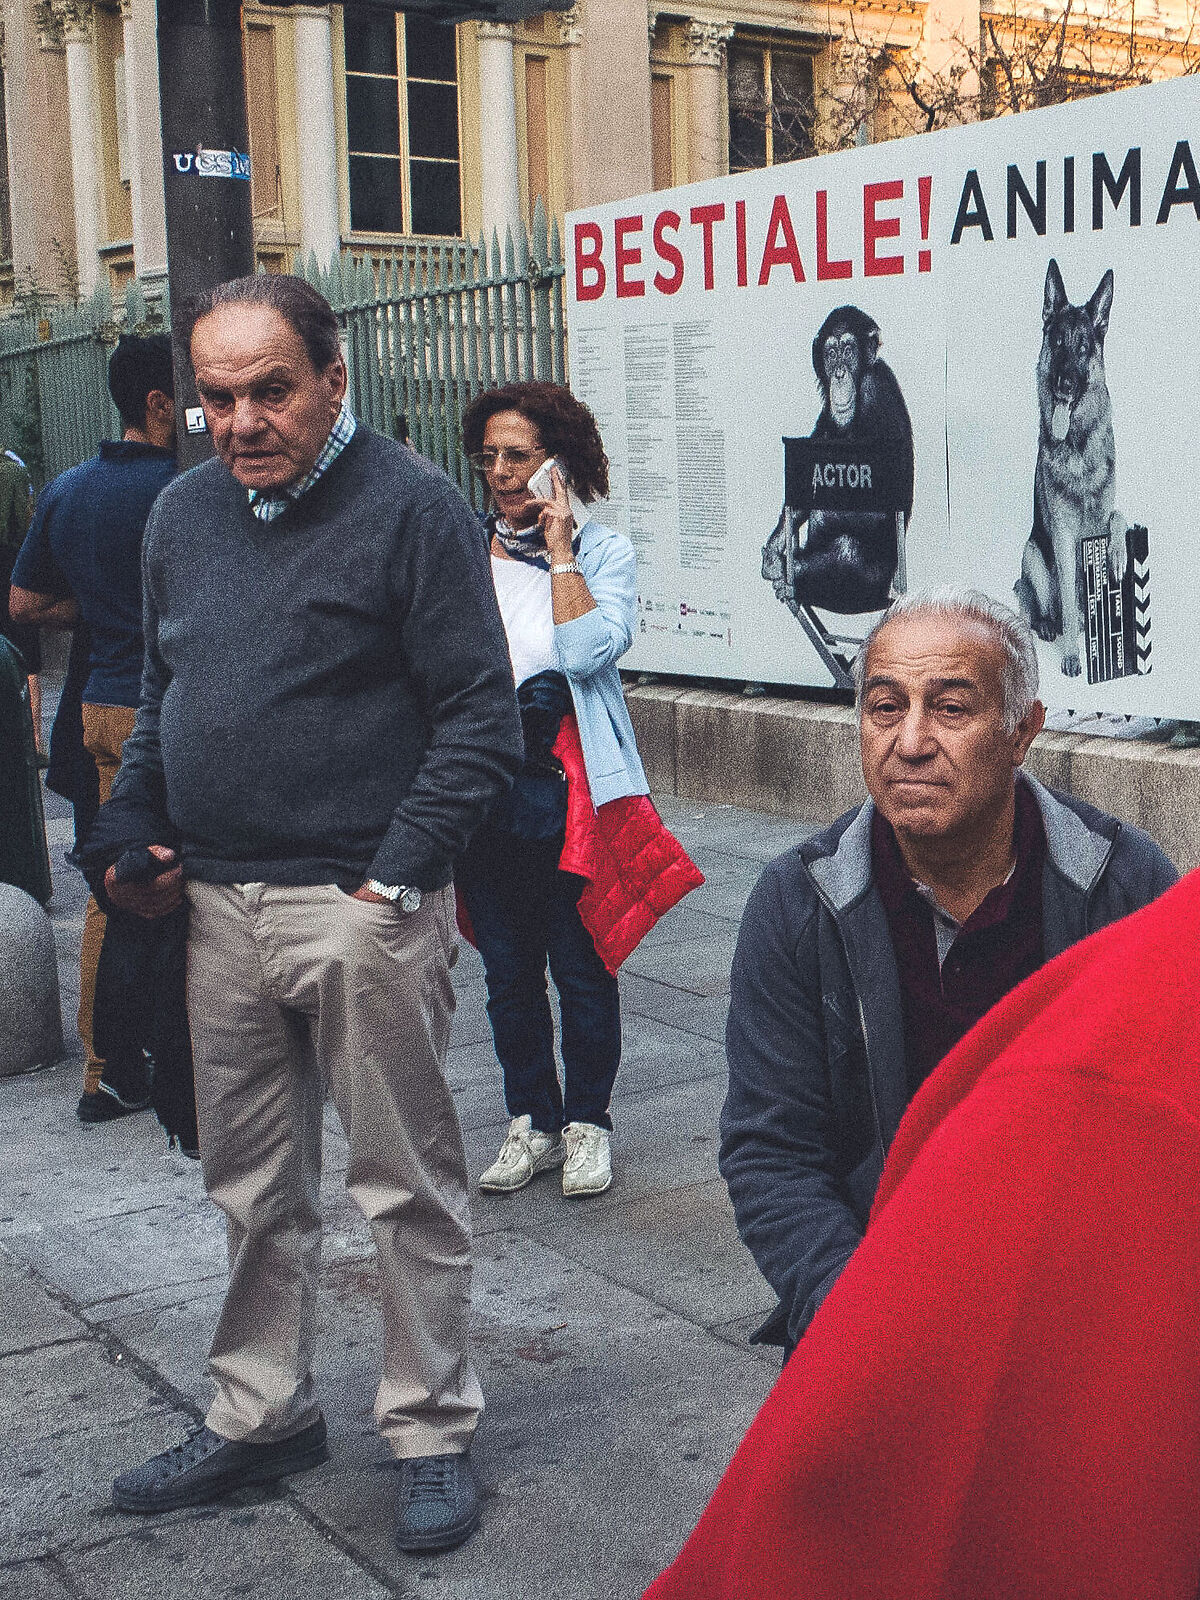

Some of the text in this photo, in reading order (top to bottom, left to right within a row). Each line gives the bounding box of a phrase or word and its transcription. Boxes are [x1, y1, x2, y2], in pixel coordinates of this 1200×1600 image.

[574, 175, 932, 302] BESTIALE!
[811, 462, 873, 489] ACTOR
[1093, 538, 1102, 602] CAMERAMAN
[1100, 537, 1108, 586] DIRECTOR
